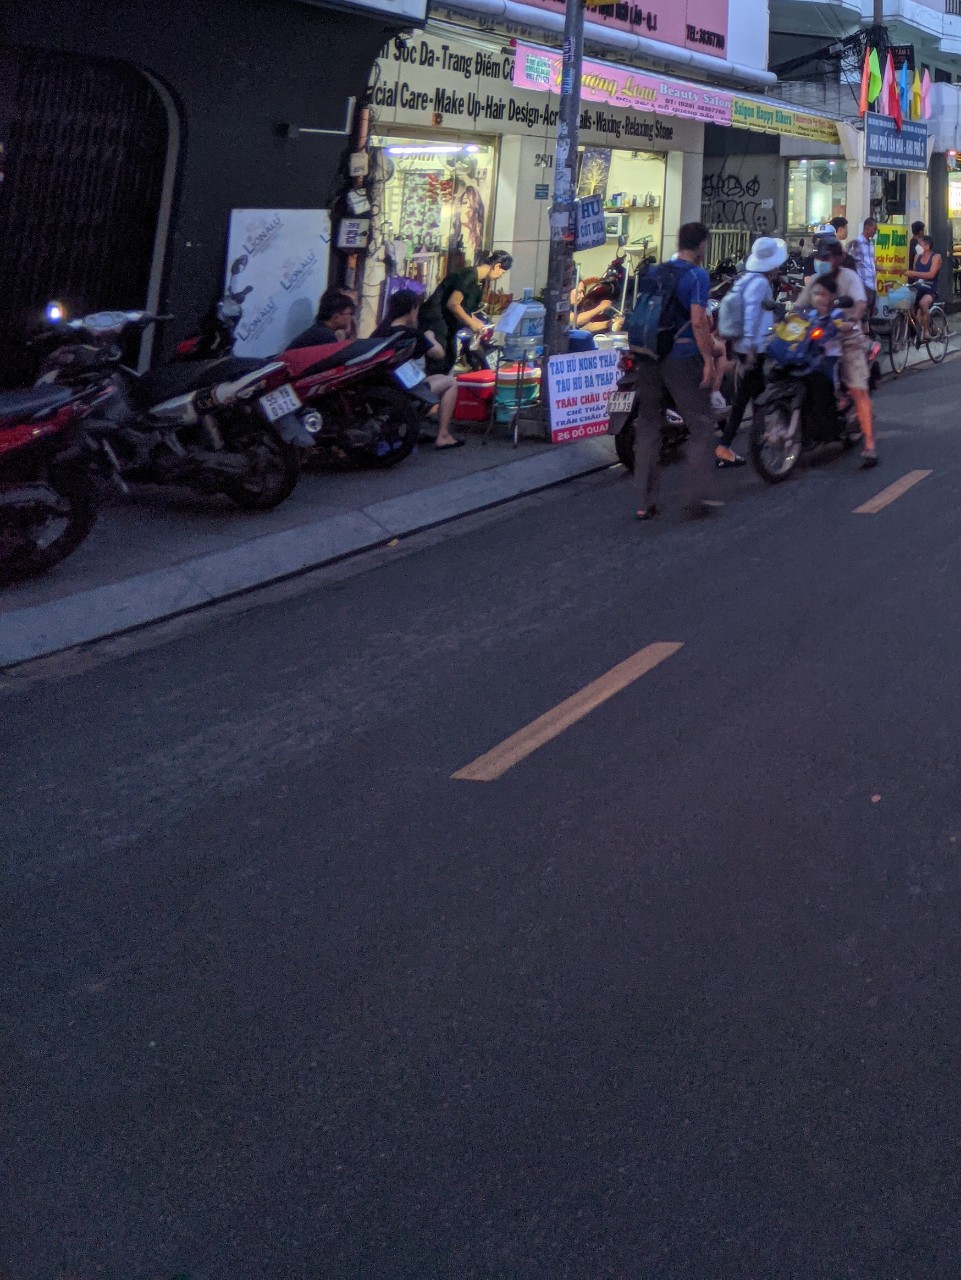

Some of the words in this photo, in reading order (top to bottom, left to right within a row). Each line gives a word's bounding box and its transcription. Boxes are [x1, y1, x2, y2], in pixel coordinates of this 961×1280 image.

[368, 81, 398, 107] acial
[660, 83, 699, 101] Beauty
[703, 93, 731, 108] Salon
[557, 431, 571, 441] 26
